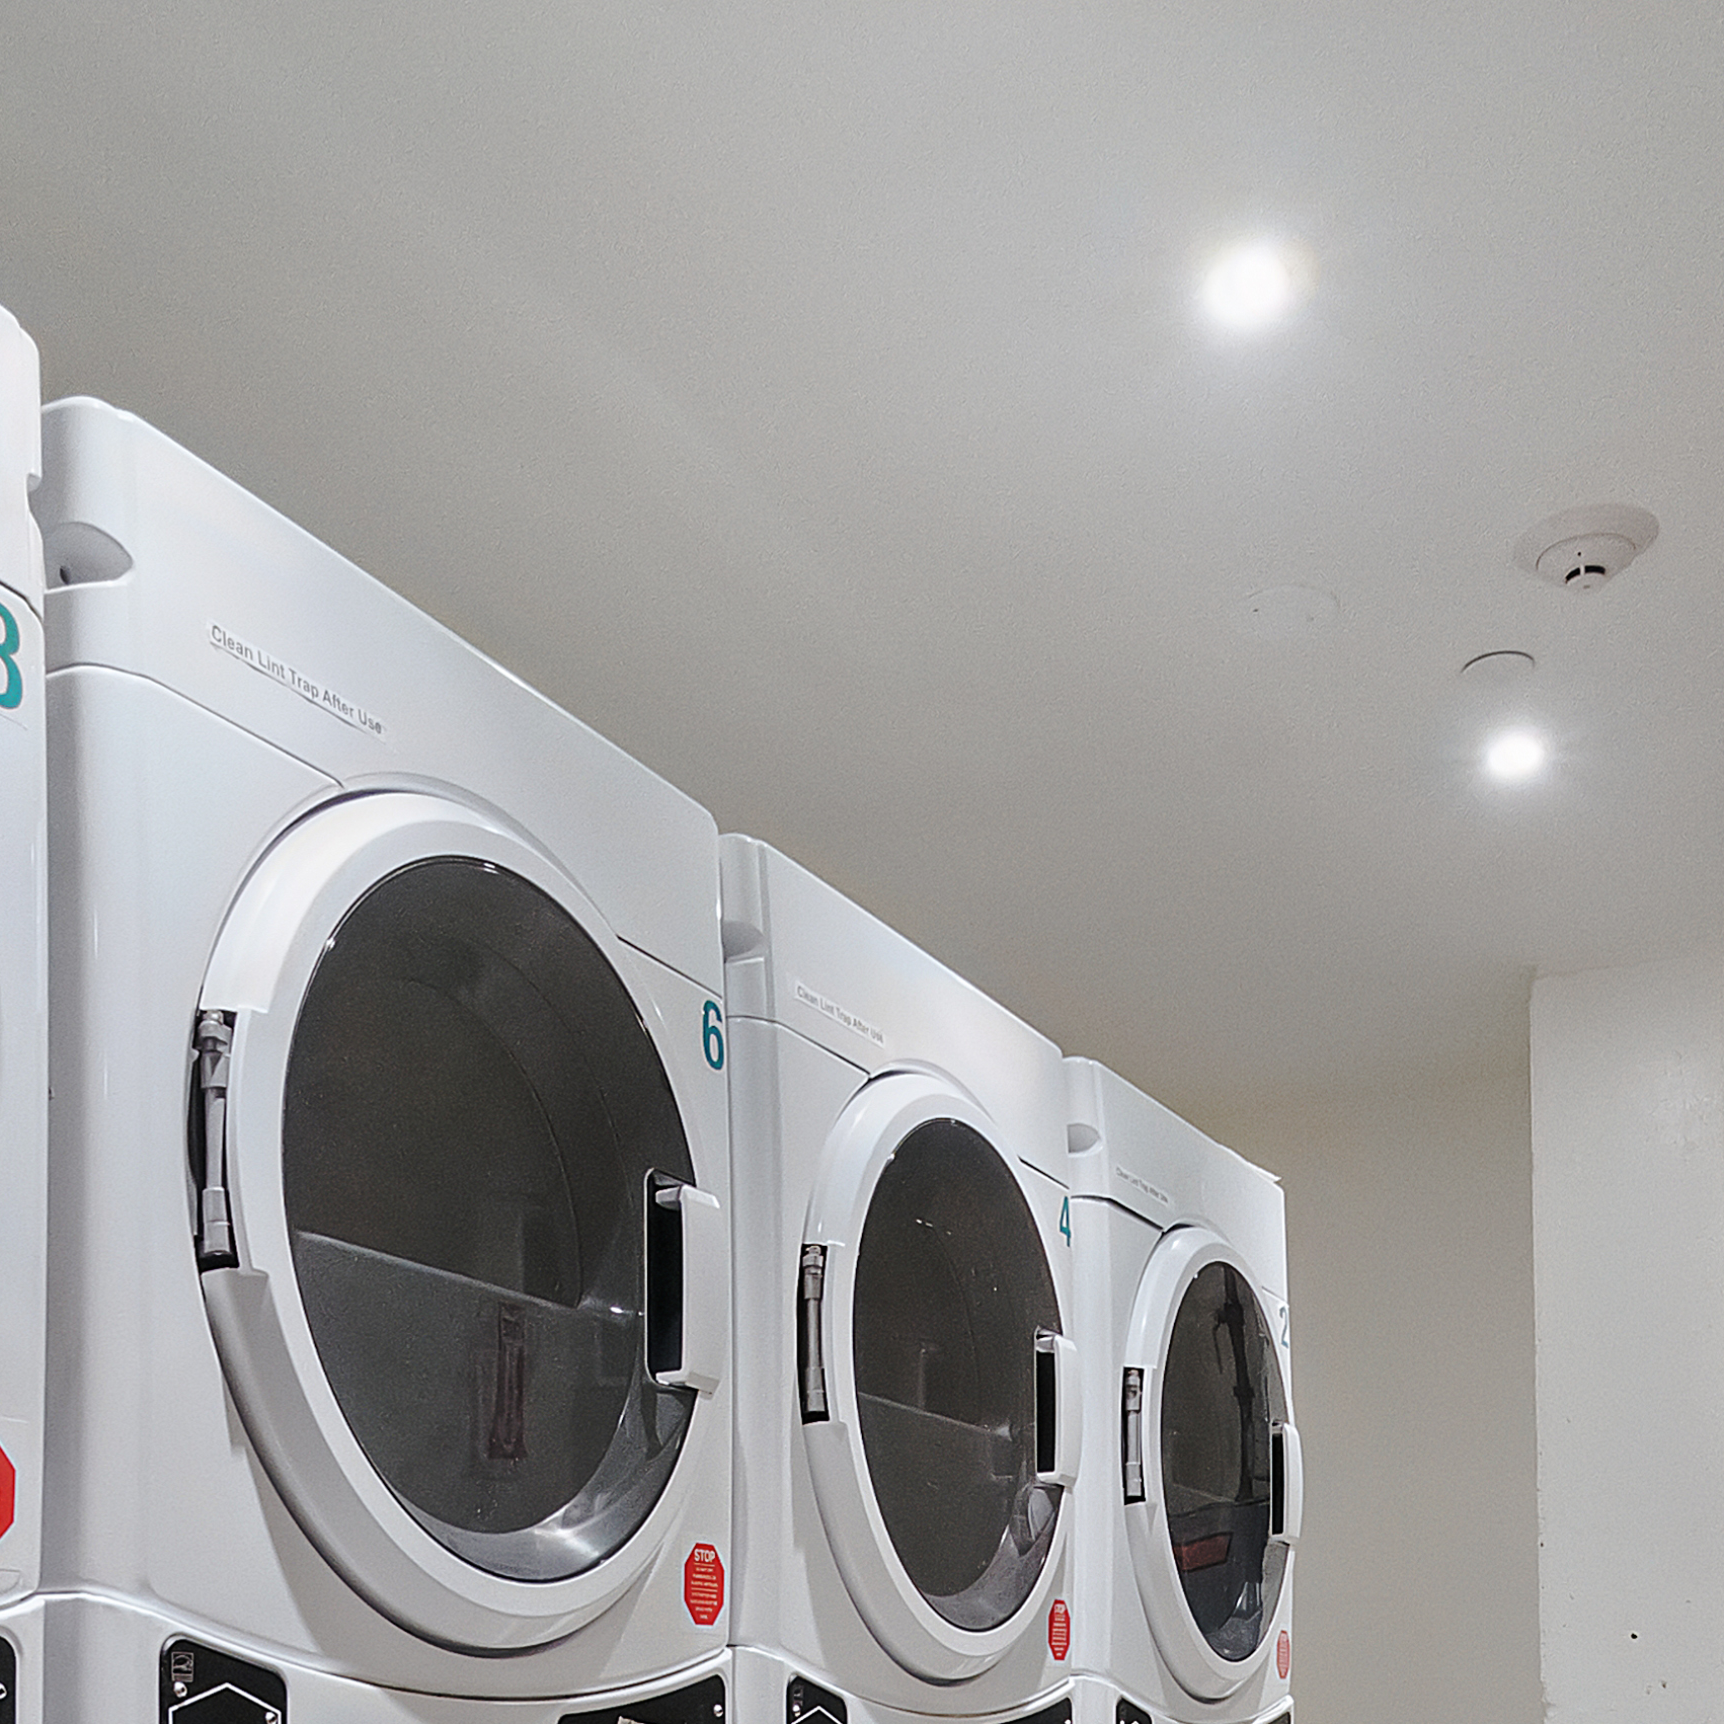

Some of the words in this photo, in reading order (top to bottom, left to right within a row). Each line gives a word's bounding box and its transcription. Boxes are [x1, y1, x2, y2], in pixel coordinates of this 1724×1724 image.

[210, 624, 254, 661] Clean
[257, 650, 286, 680] Lint
[288, 667, 320, 700] Trap
[322, 689, 355, 718] After
[357, 708, 383, 735] Use
[702, 999, 725, 1070] 6
[1059, 1195, 1071, 1248] 4
[1279, 1304, 1290, 1349] 2
[694, 1548, 716, 1562] STOP
